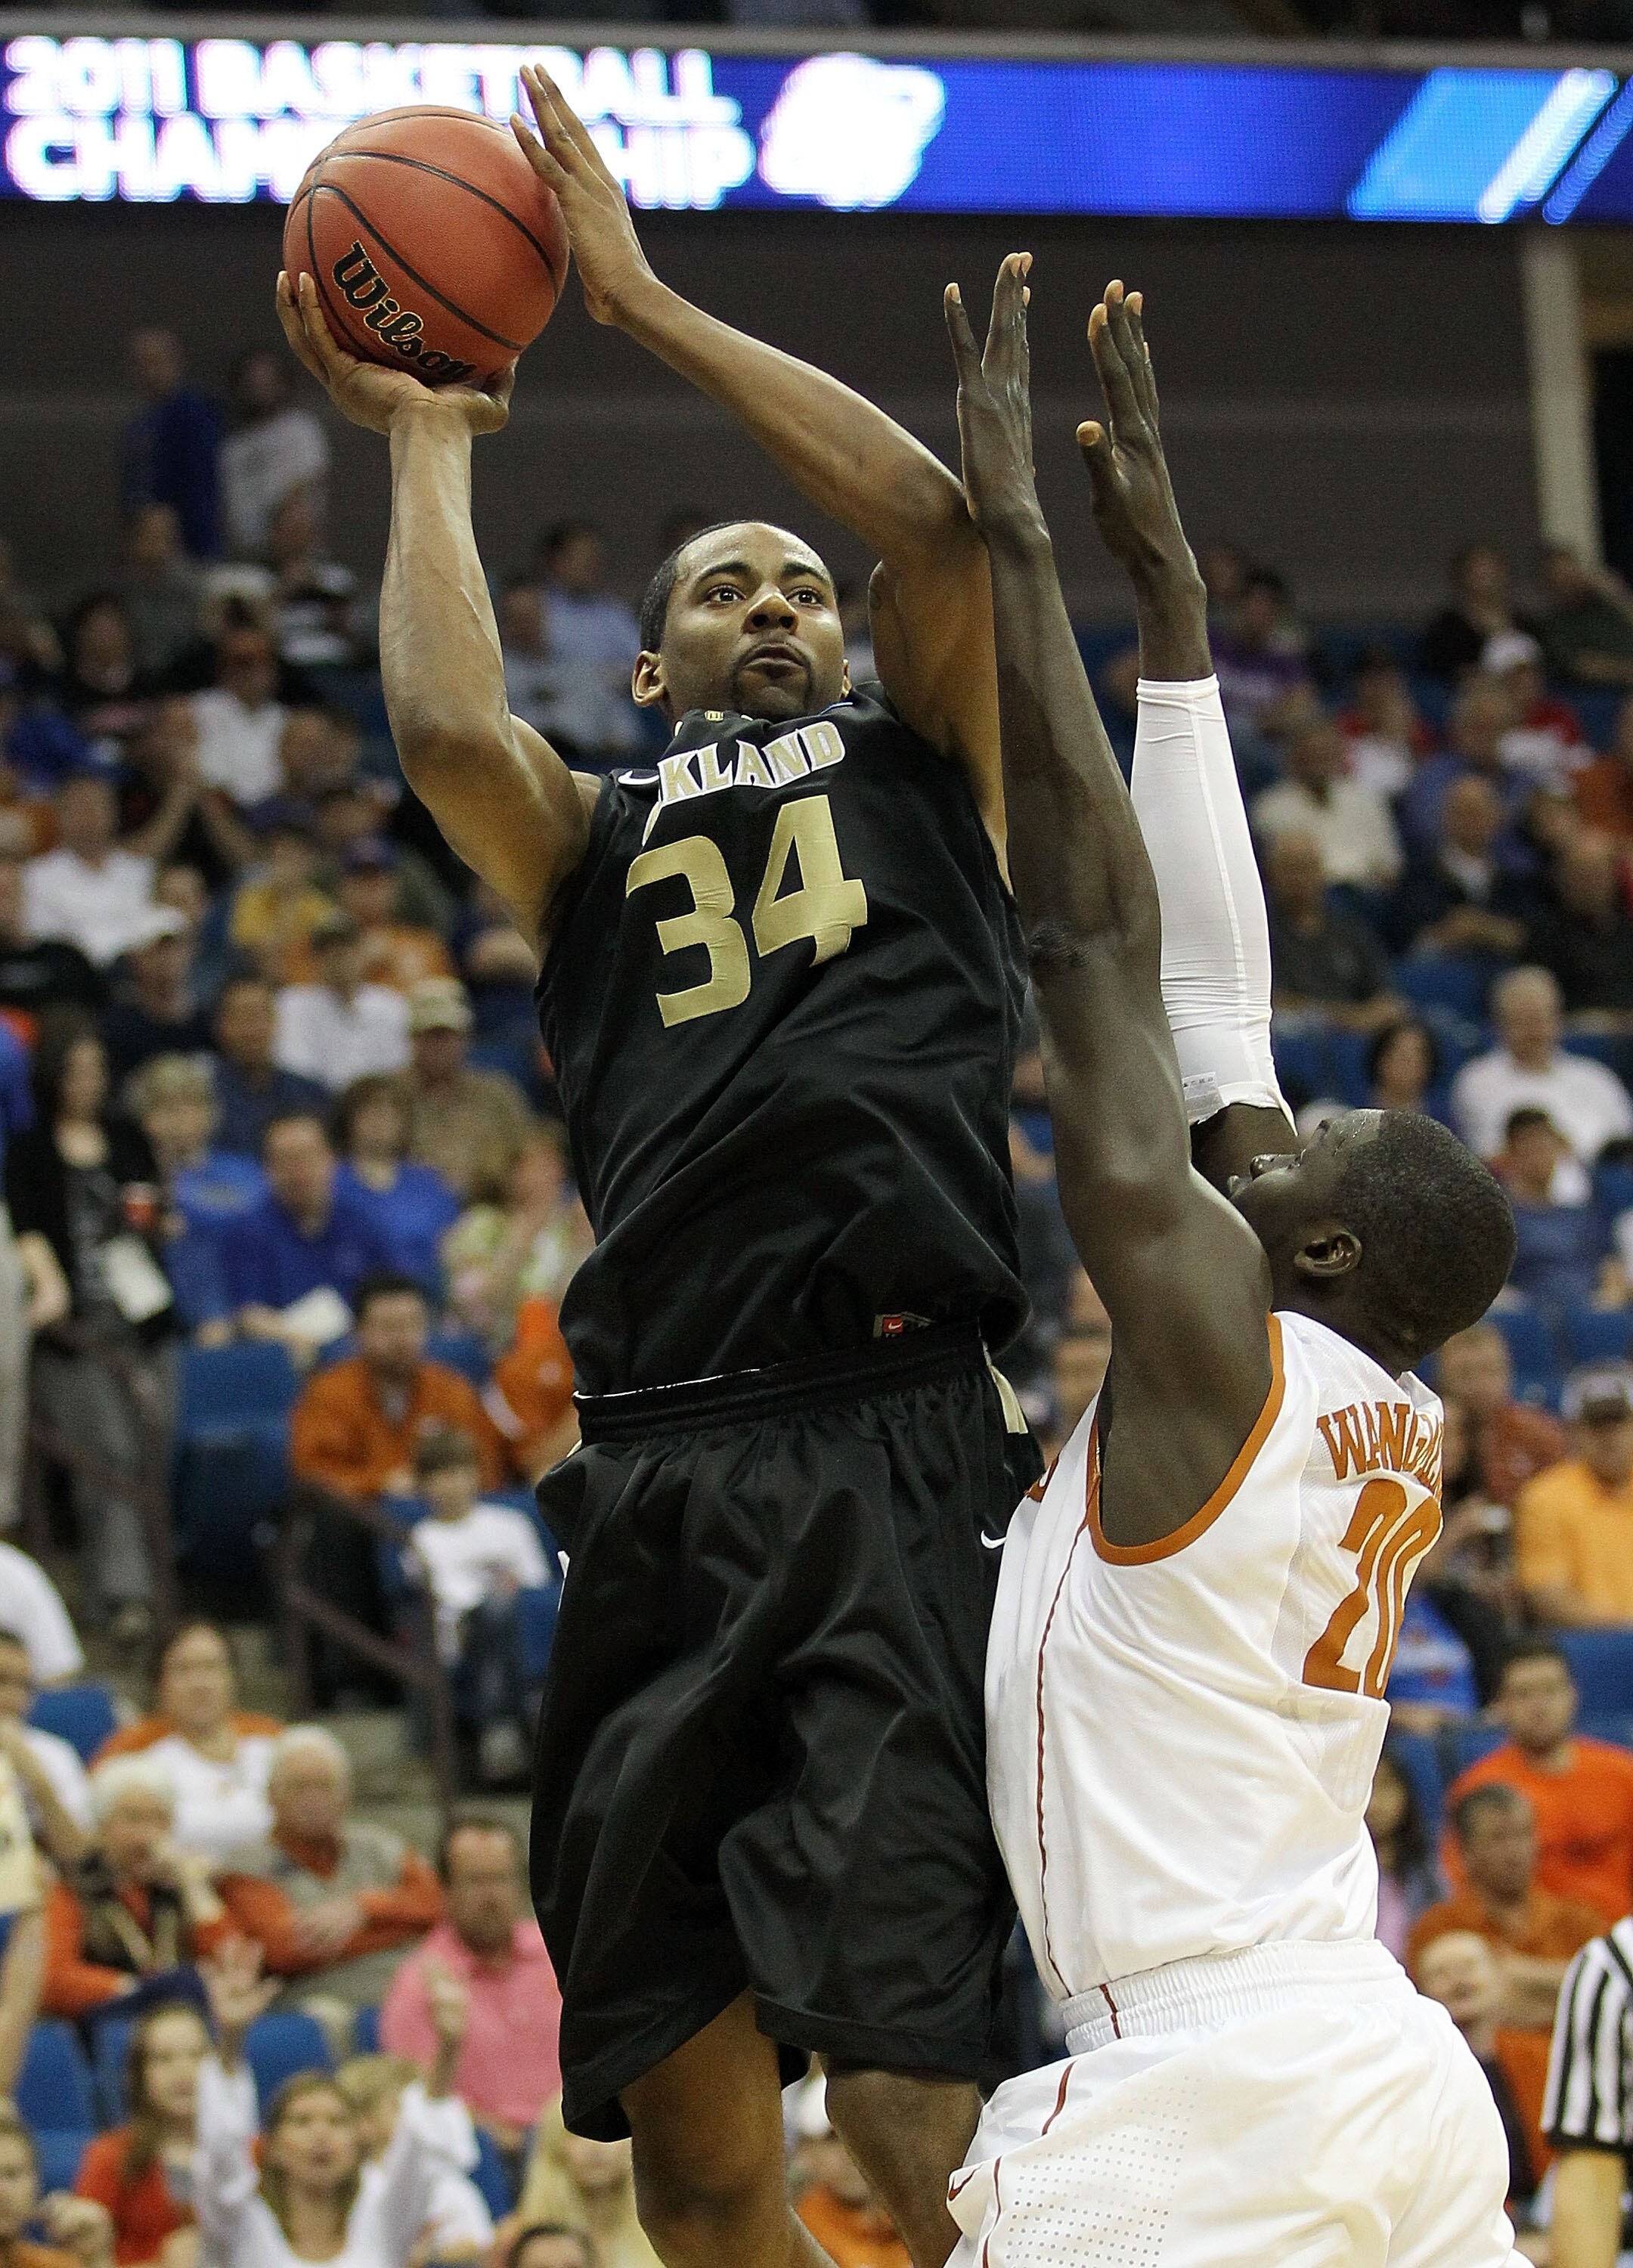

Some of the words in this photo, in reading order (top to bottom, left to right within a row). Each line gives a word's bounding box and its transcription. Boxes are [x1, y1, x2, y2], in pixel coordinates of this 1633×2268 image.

[5, 36, 187, 116] 2011
[194, 38, 743, 126] BASKETBALL
[5, 111, 755, 210] CHAMHIP
[332, 239, 477, 378] Wilson
[656, 720, 846, 807] KLAND
[625, 794, 868, 1028] 34
[1302, 1478, 1443, 1699] 20
